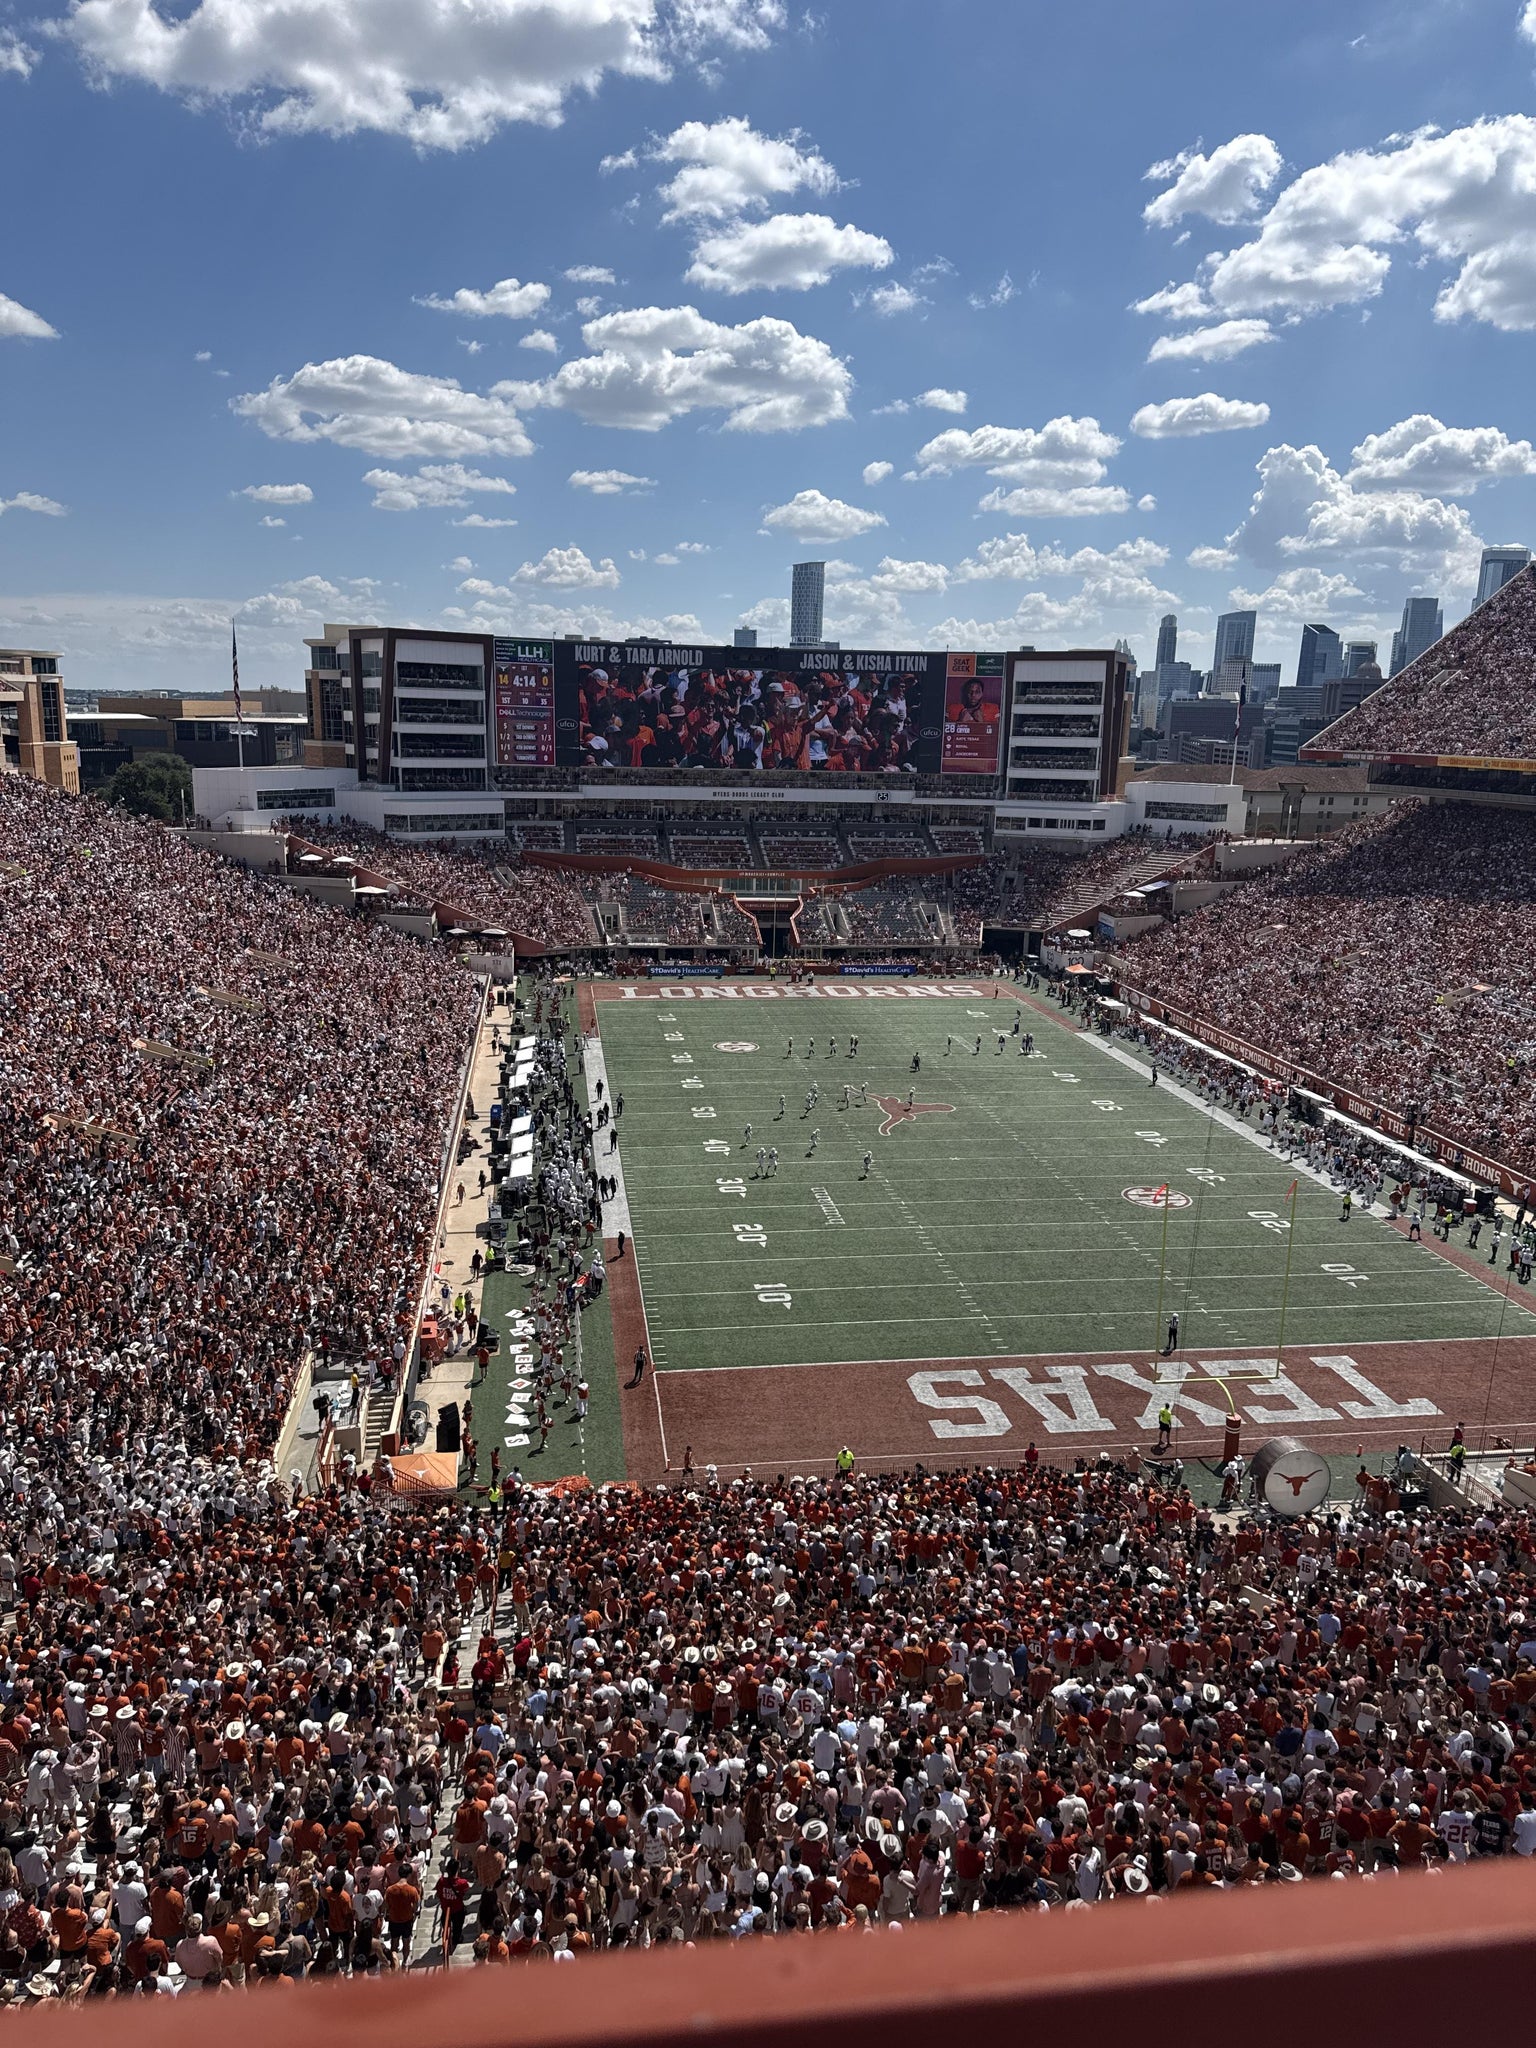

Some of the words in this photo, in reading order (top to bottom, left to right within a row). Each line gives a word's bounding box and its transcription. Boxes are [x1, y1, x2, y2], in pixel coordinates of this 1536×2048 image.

[517, 645, 543, 658] LLH
[575, 645, 604, 662] KURT
[609, 646, 621, 663] &
[625, 647, 655, 664] TARA
[657, 648, 702, 666] ARNOLD
[800, 653, 838, 669] JASON
[842, 655, 854, 671] &
[857, 655, 891, 671] KISHA
[895, 656, 927, 672] ITKIN
[499, 674, 509, 685] 14
[512, 675, 536, 687] 4:14
[542, 676, 549, 686] 0
[944, 724, 956, 733] 28
[619, 985, 984, 999] LONGHORNS
[1240, 1045, 1272, 1071] MEMORIAL
[691, 1106, 717, 1117] 50
[1091, 1100, 1123, 1111] 50
[1347, 1098, 1371, 1120] HOME
[1386, 1116, 1405, 1137] THE
[1407, 1126, 1438, 1152] EXAS
[1134, 1131, 1169, 1143] 40
[702, 1139, 731, 1153] 40
[1186, 1167, 1226, 1182] 30
[716, 1177, 747, 1193] 30
[1247, 1210, 1292, 1228] 20
[732, 1223, 768, 1242] 20
[1321, 1263, 1370, 1281] 10
[754, 1283, 792, 1303] 10
[906, 1355, 1444, 1440] TEXAS
[1301, 1563, 1311, 1573] 16
[954, 1650, 960, 1662] 1
[761, 1694, 776, 1708] 16
[797, 1699, 811, 1713] 16
[182, 1831, 197, 1843] 16
[576, 1827, 583, 1841] 1
[1320, 1826, 1332, 1840] 12
[1206, 1855, 1222, 1871] 16
